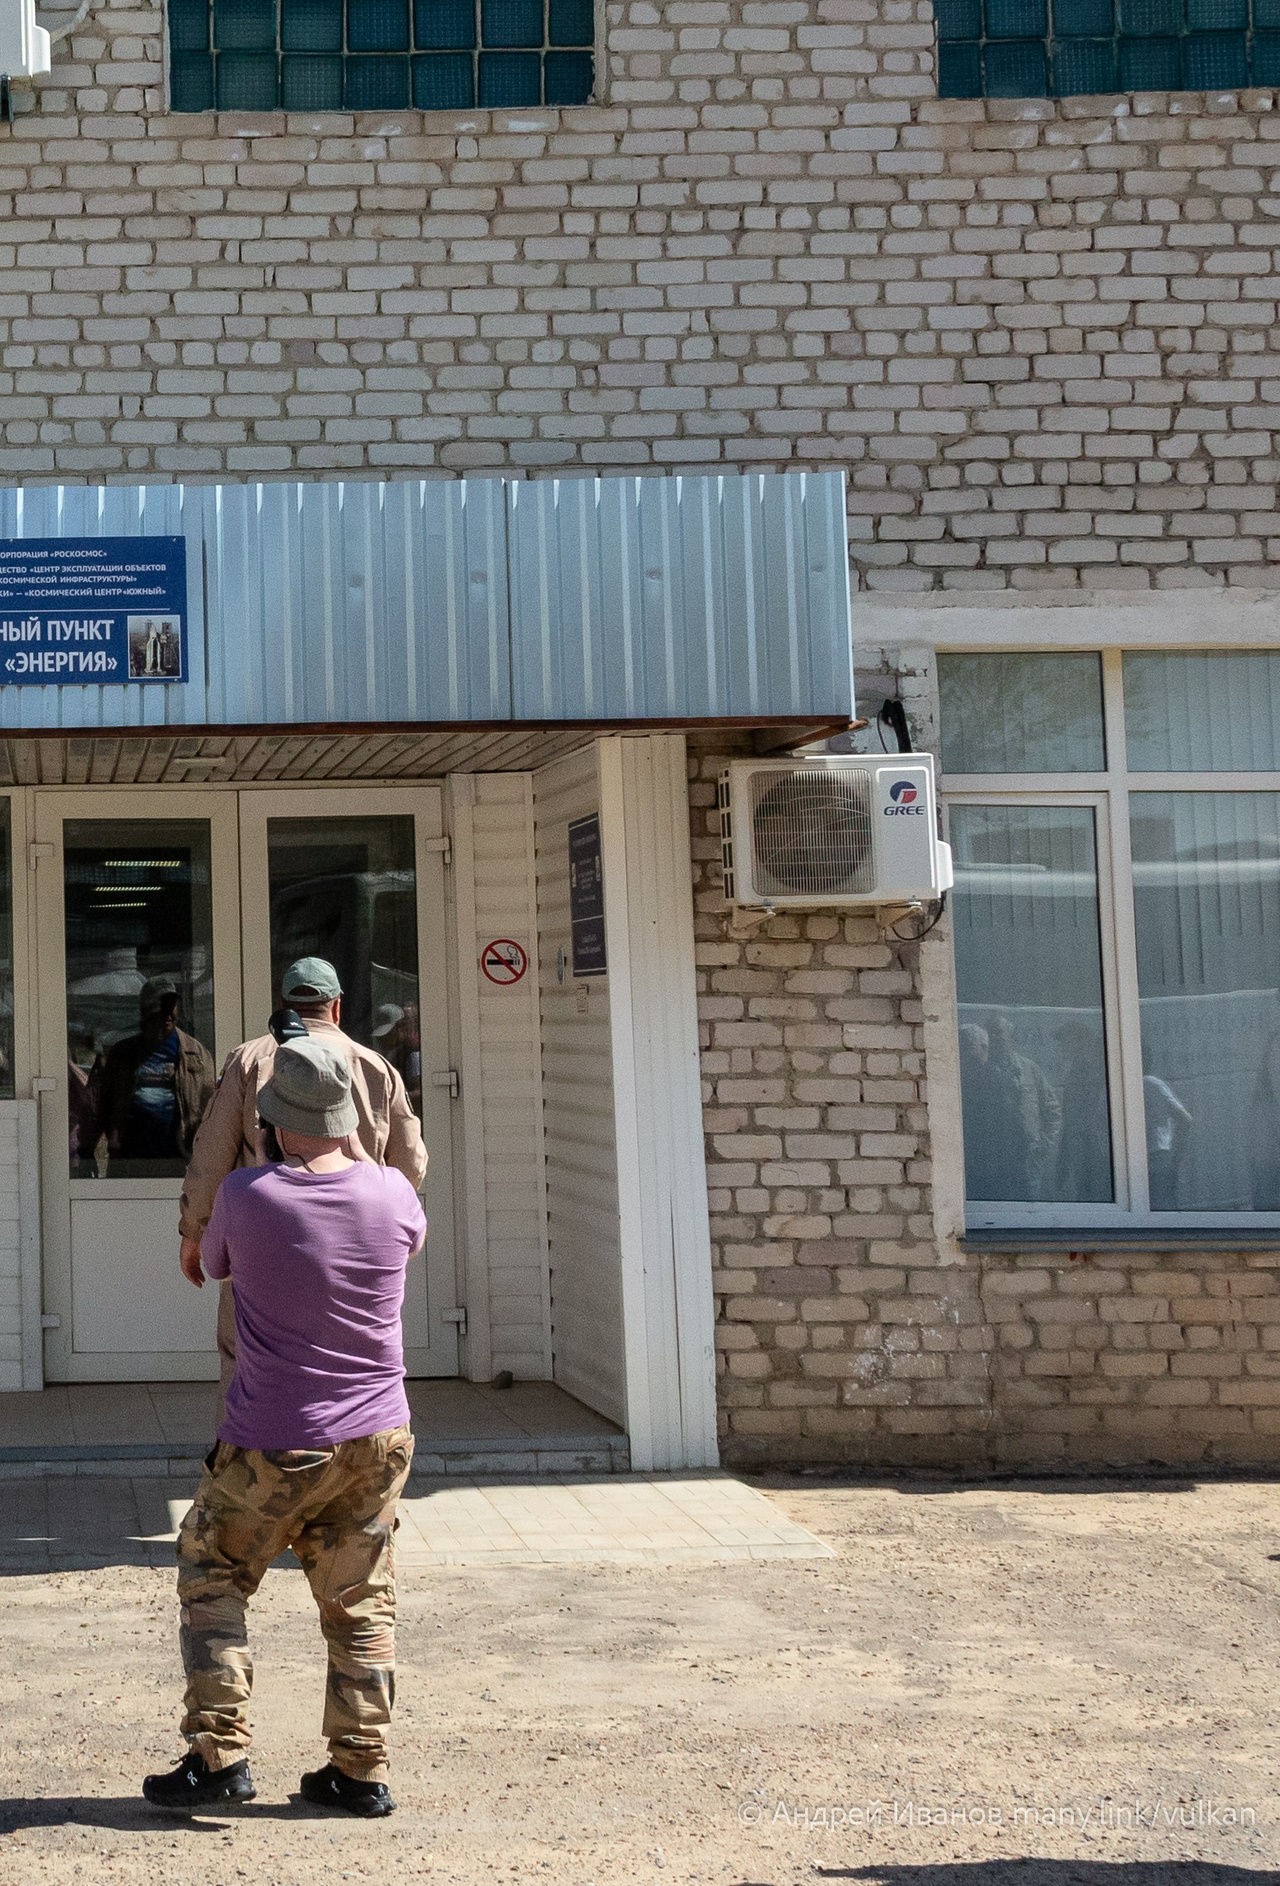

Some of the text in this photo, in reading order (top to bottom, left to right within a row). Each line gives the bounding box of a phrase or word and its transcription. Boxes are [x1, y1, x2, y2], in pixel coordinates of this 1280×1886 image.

[50, 549, 108, 558] «РОСКОСМОС»
[29, 565, 60, 574] «ЦЕНТР
[61, 565, 123, 573] ЭКСПЛУАТАЦИИ
[124, 564, 167, 572] ОБЪЕКТОВ
[60, 575, 137, 583] ИНФРАСТРУКТУРЫ»
[24, 587, 93, 598] «КОСМИЧЕСКИЙ
[47, 620, 115, 640] ПУНКТ
[4, 651, 118, 673] «ЭНЕРГИЯ»
[883, 805, 925, 816] GREE
